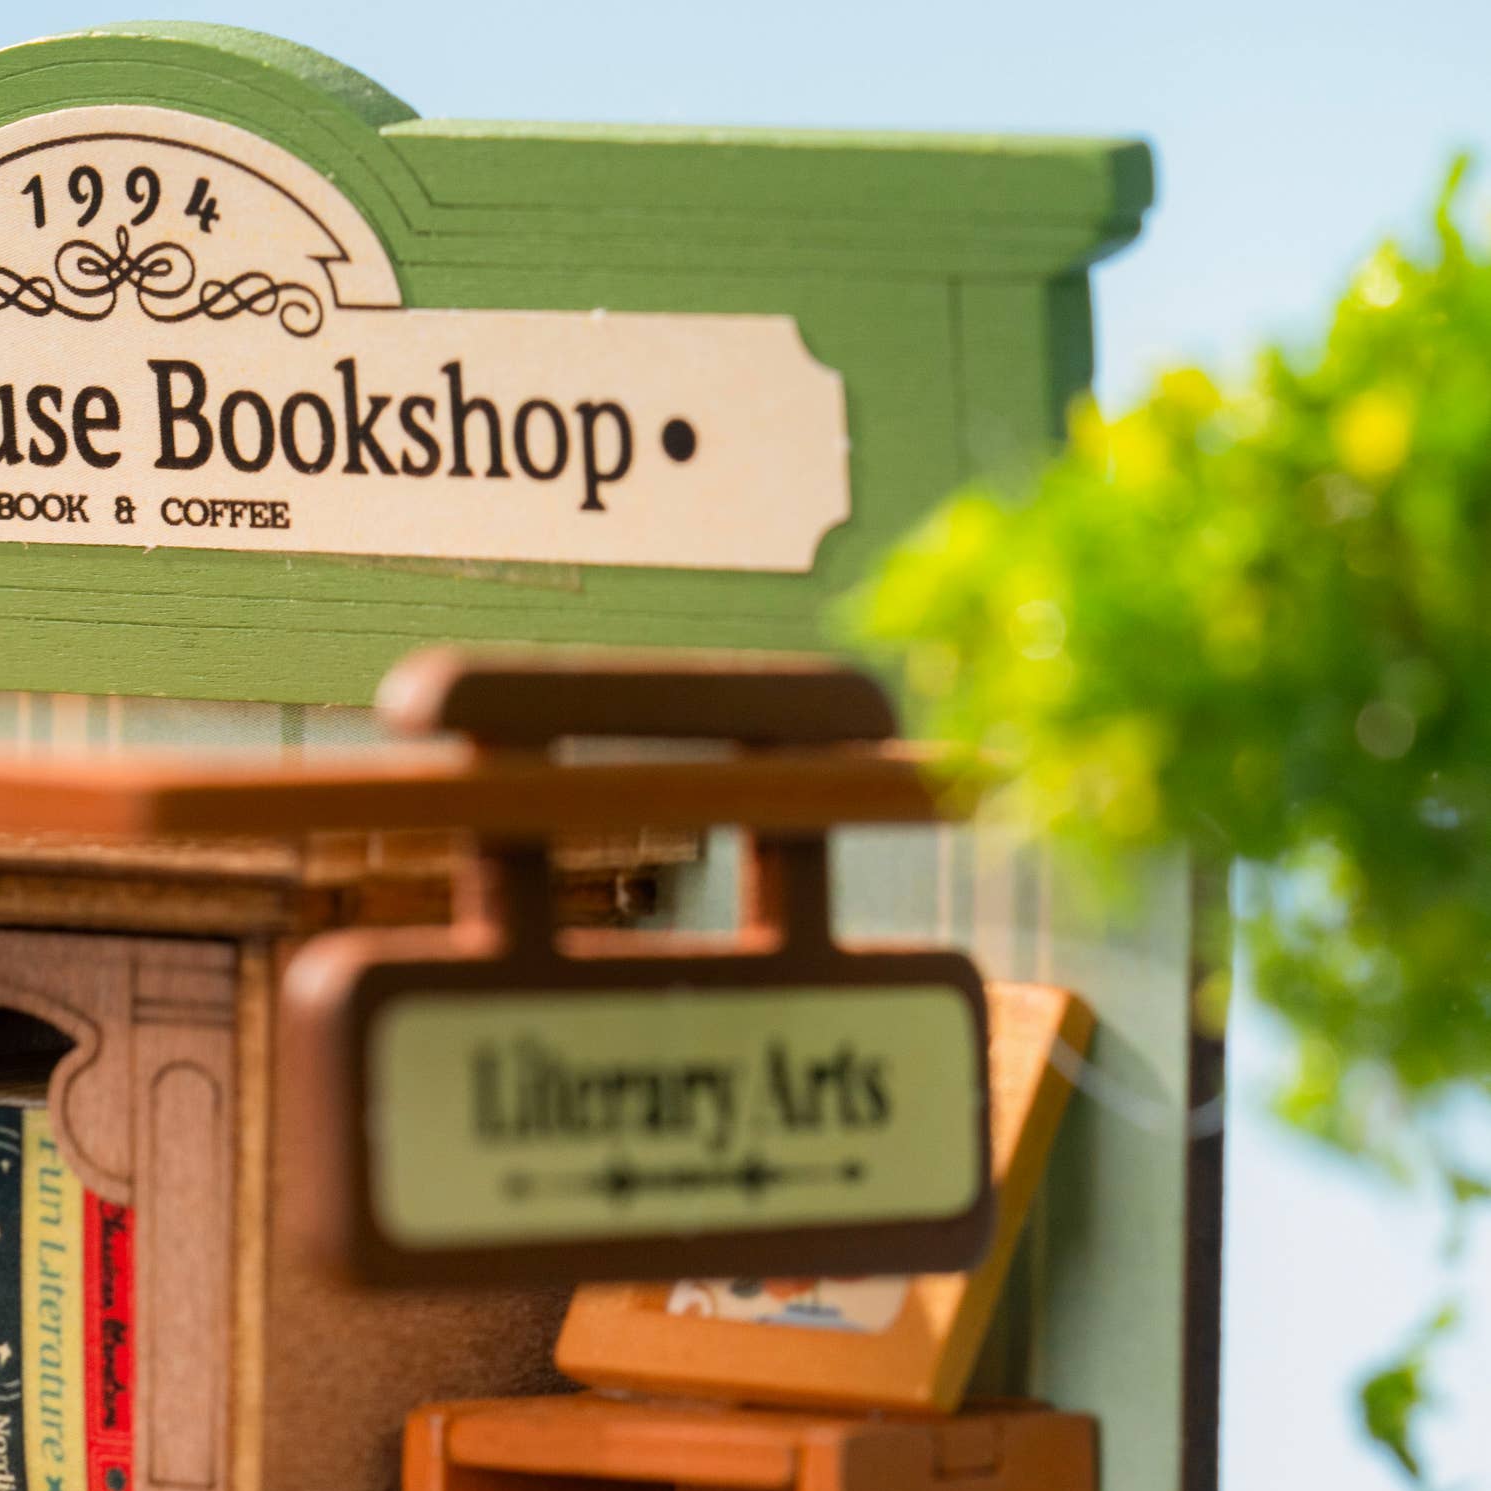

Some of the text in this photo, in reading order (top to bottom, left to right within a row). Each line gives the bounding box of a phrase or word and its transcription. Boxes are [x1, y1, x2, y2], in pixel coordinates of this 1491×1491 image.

[19, 164, 222, 234] 1994
[146, 357, 634, 512] Bookshop
[114, 495, 138, 525] &
[160, 497, 291, 530] COFFEE
[467, 1036, 894, 1151] Literary Arts
[37, 1240, 67, 1463] Literature
